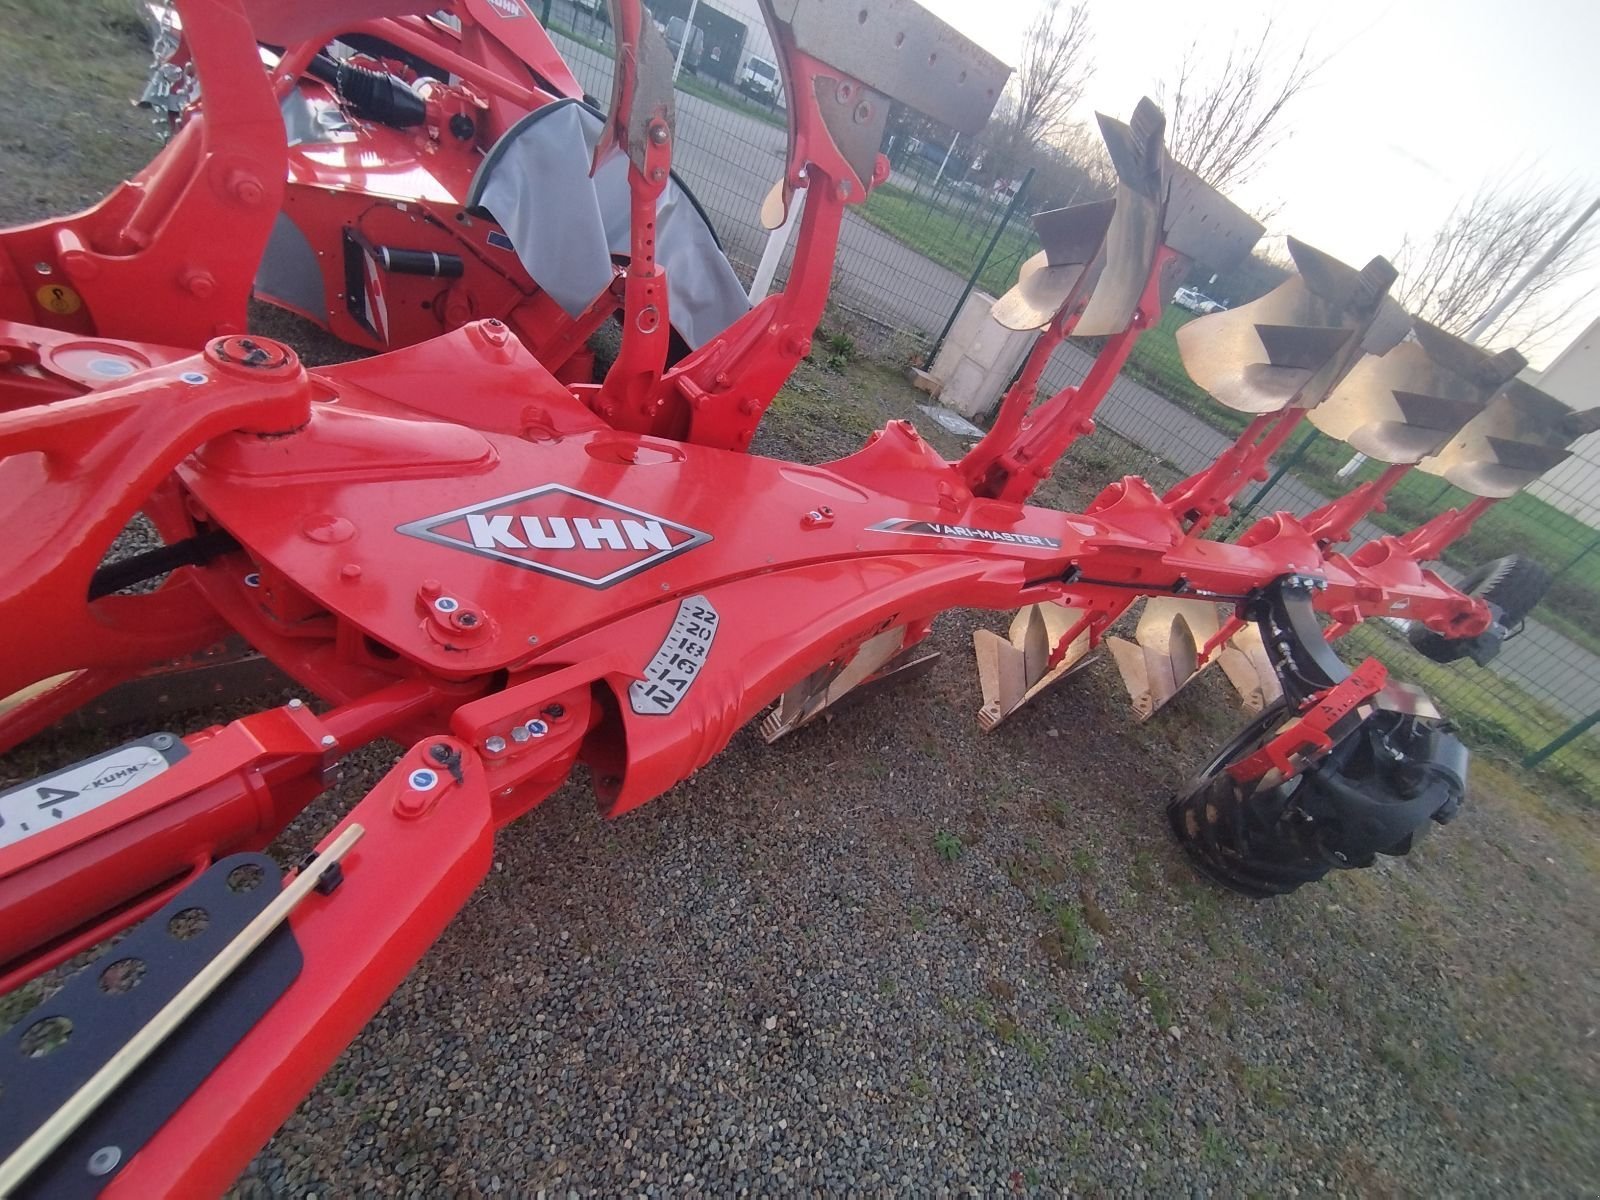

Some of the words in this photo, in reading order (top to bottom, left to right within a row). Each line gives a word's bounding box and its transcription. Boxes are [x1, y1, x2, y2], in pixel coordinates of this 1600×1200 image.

[465, 514, 674, 550] KUHN
[927, 522, 1043, 545] VARI-MASTER
[1045, 537, 1059, 547] L
[692, 606, 717, 625] 22
[686, 622, 711, 640] 20
[678, 638, 705, 657] 18
[669, 653, 697, 674] 16
[657, 669, 688, 691] 14
[644, 684, 675, 709] 12
[92, 765, 139, 788] KUHN
